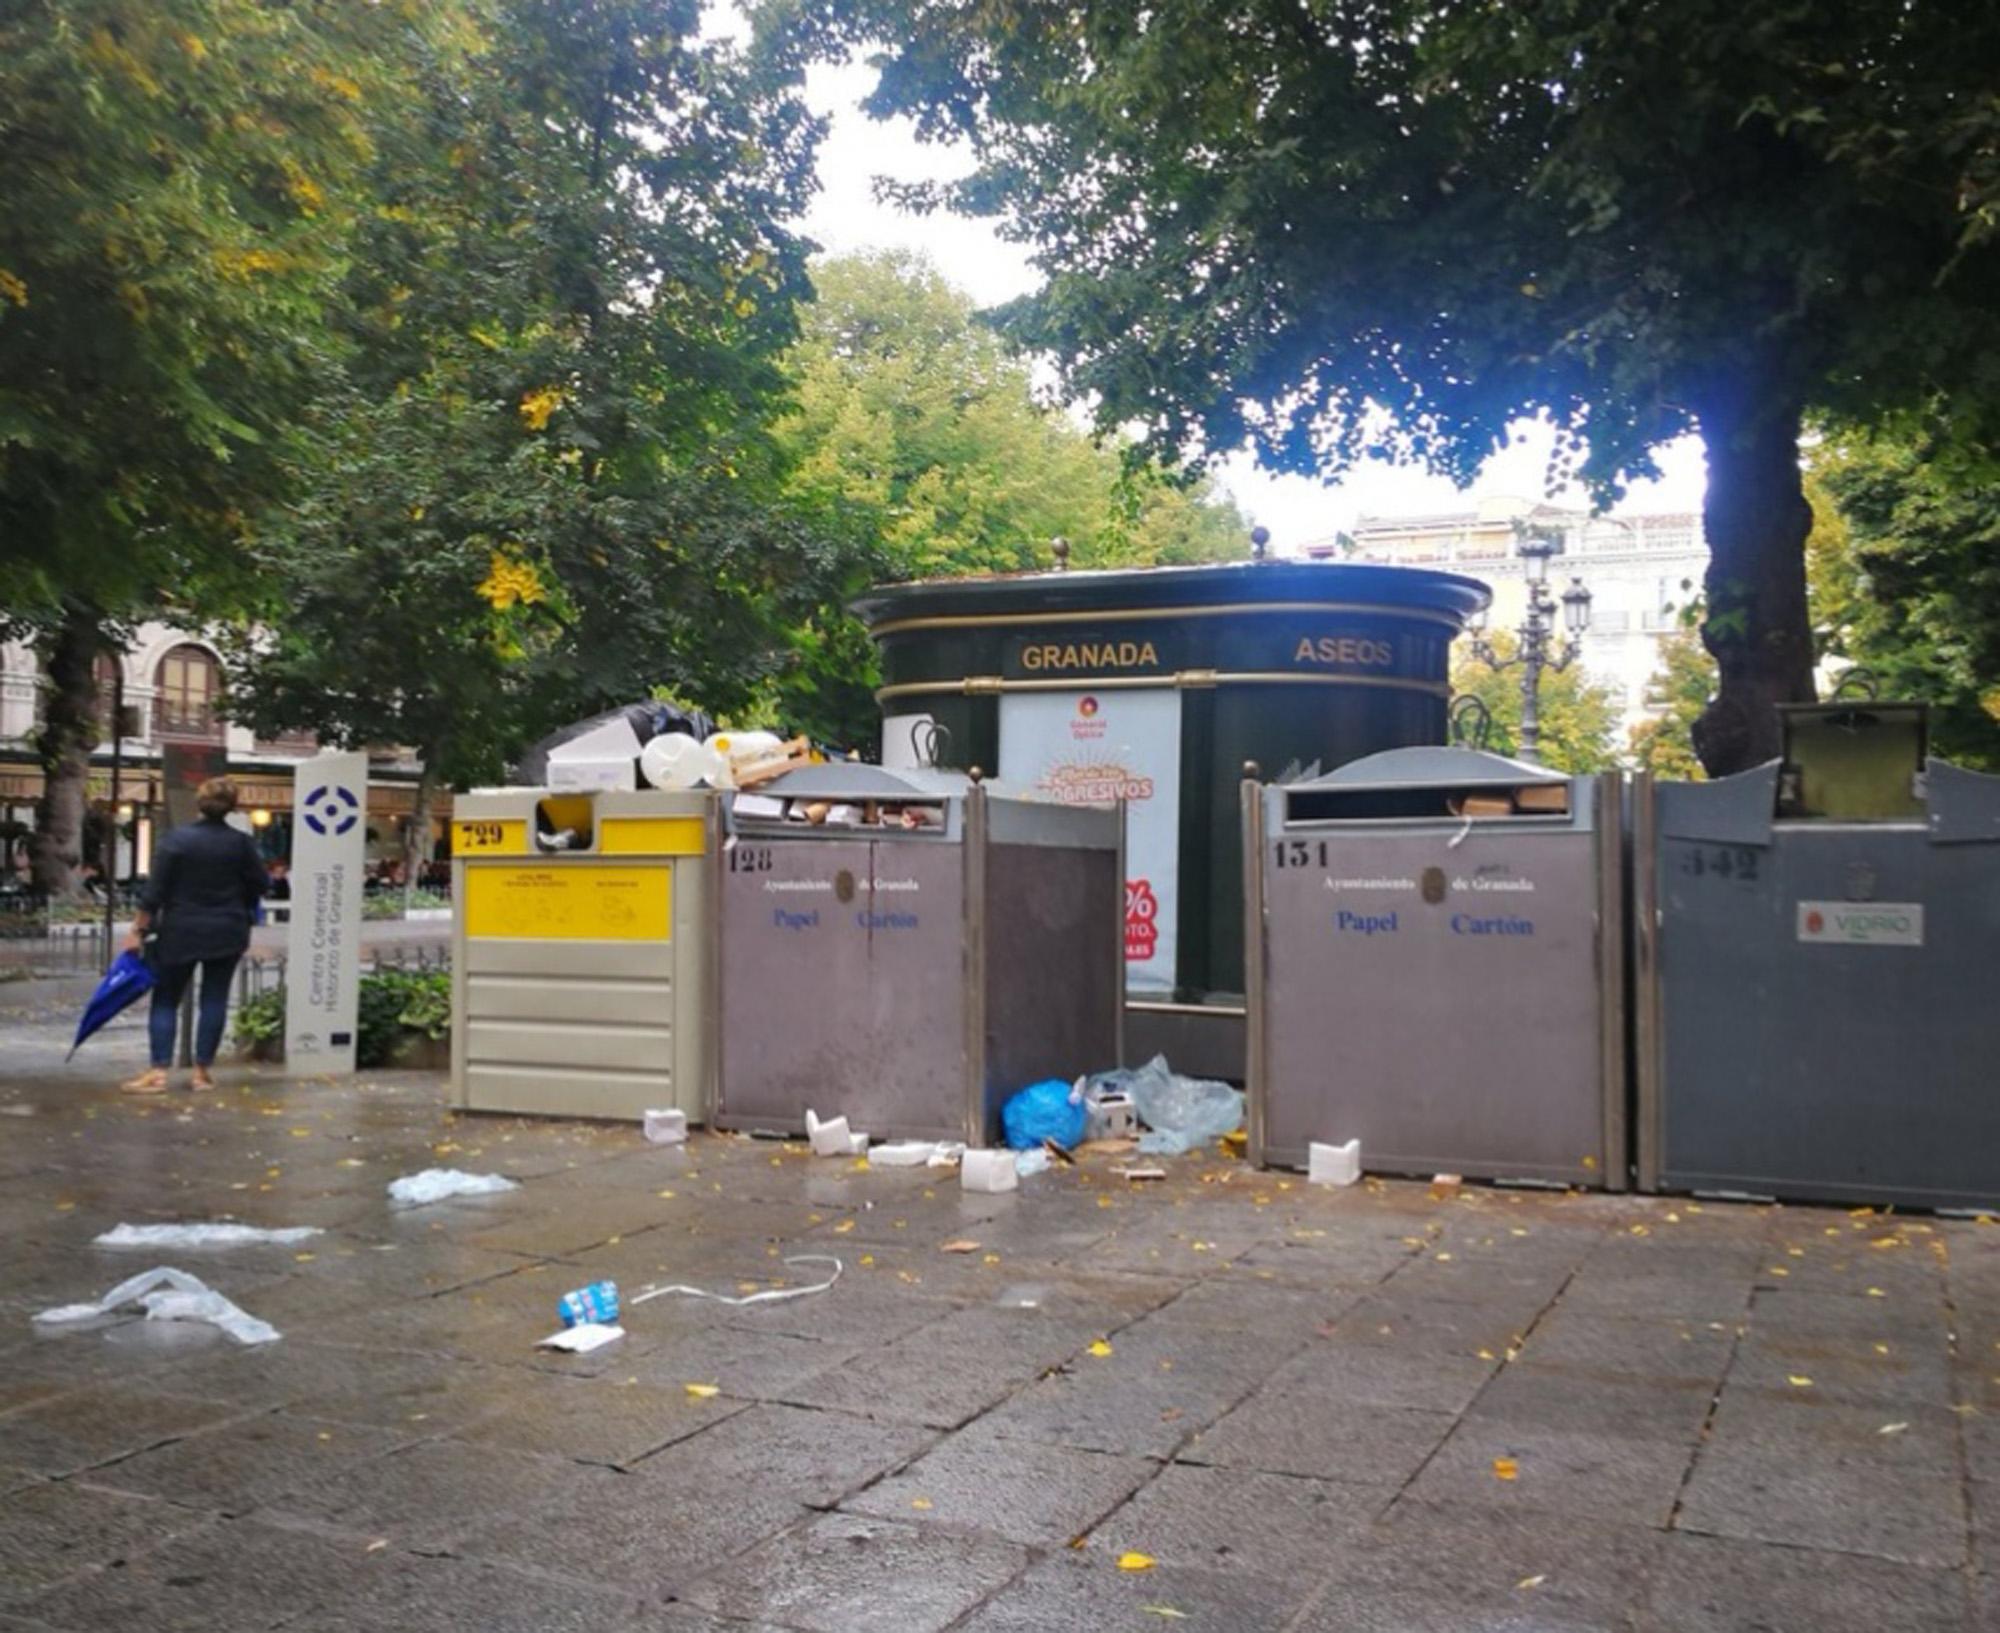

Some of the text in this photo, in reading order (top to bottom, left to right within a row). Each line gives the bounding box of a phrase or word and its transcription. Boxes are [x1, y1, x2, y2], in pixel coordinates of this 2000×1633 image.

[1022, 642, 1159, 670] GRANADA
[1295, 638, 1393, 665] ASEOS
[462, 823, 503, 847] 729
[730, 848, 773, 873] 128
[1275, 841, 1328, 868] 131
[328, 863, 345, 925] Granada
[764, 877, 832, 893] Ayuntamiento
[873, 877, 920, 891] Granada
[1323, 876, 1535, 892] Ayuntamiento de Granada
[774, 906, 818, 929] Papel
[1337, 911, 1534, 935] Papel Cartón
[1835, 913, 1911, 932] VIDRIO
[309, 872, 328, 1006] Centro Comercial
[328, 928, 341, 946] de
